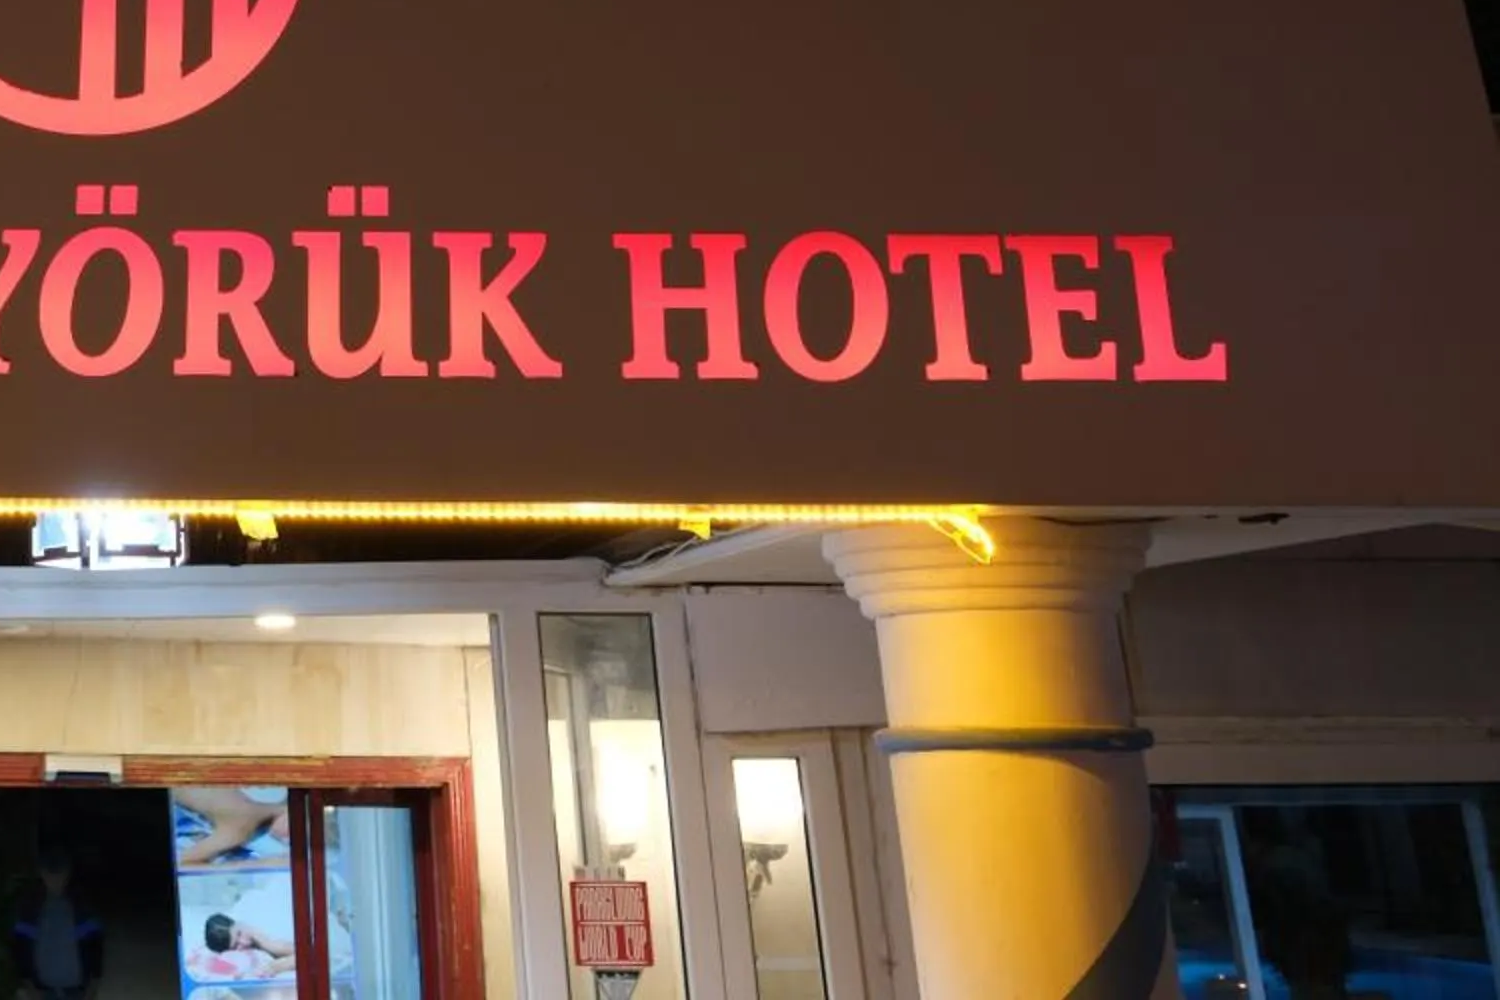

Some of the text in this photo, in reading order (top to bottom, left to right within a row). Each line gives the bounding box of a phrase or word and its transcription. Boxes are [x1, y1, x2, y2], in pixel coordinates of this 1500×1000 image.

[612, 233, 1227, 382] HOTEL
[578, 924, 648, 961] WORLD CUP
